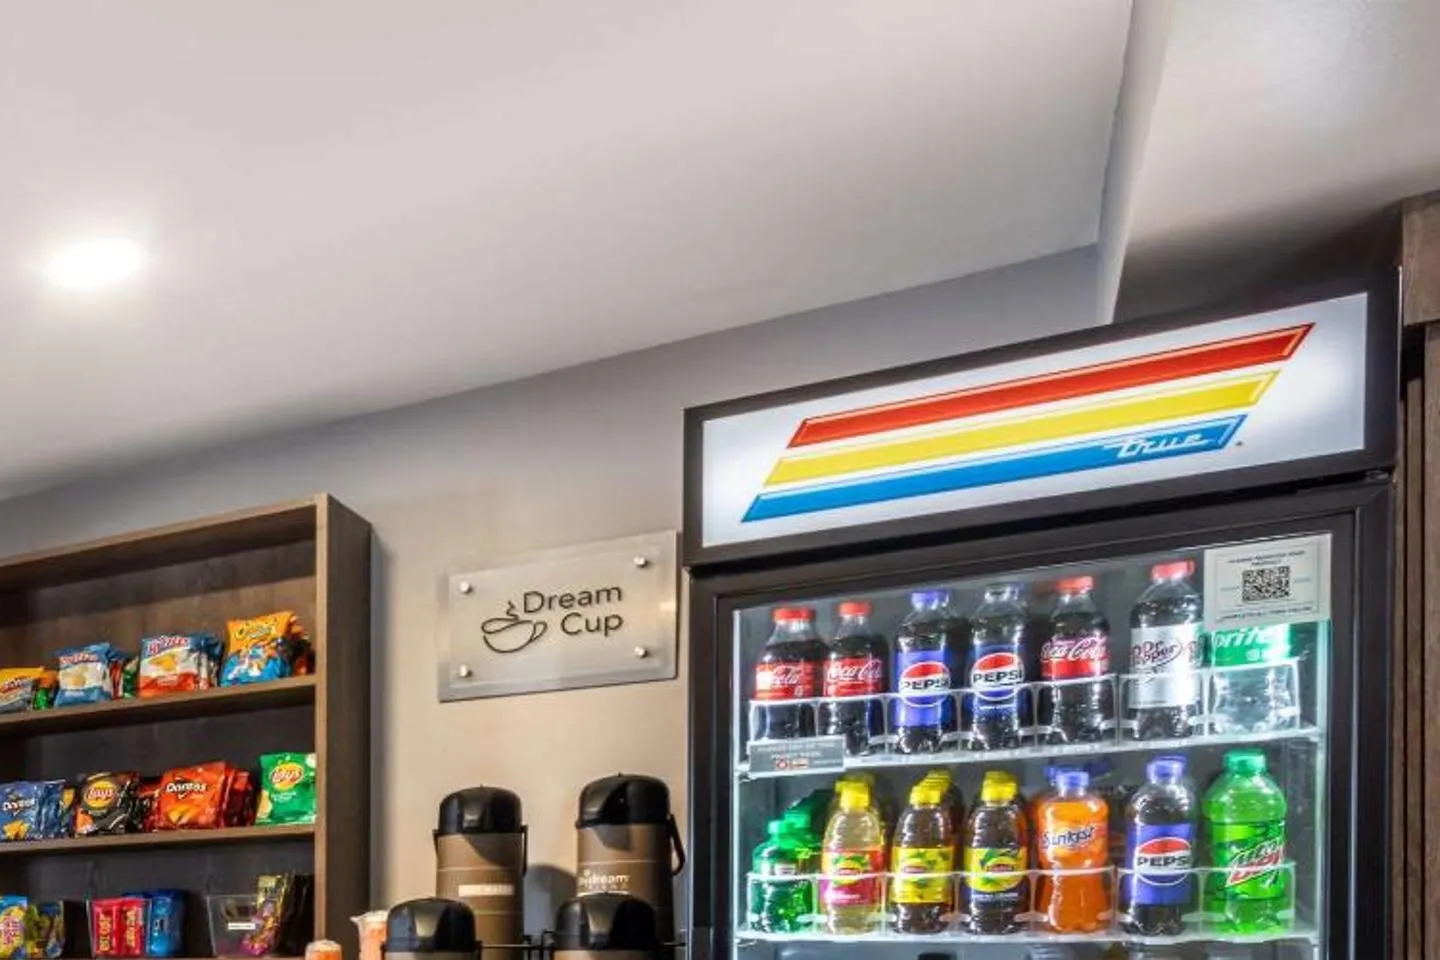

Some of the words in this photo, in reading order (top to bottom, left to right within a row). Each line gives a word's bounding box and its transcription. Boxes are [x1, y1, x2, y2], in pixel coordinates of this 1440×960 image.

[523, 587, 622, 613] Dream
[561, 612, 624, 637] Cup
[973, 669, 1023, 683] PEPSI
[166, 782, 207, 793] Doritos
[1042, 827, 1095, 847] Sunkist
